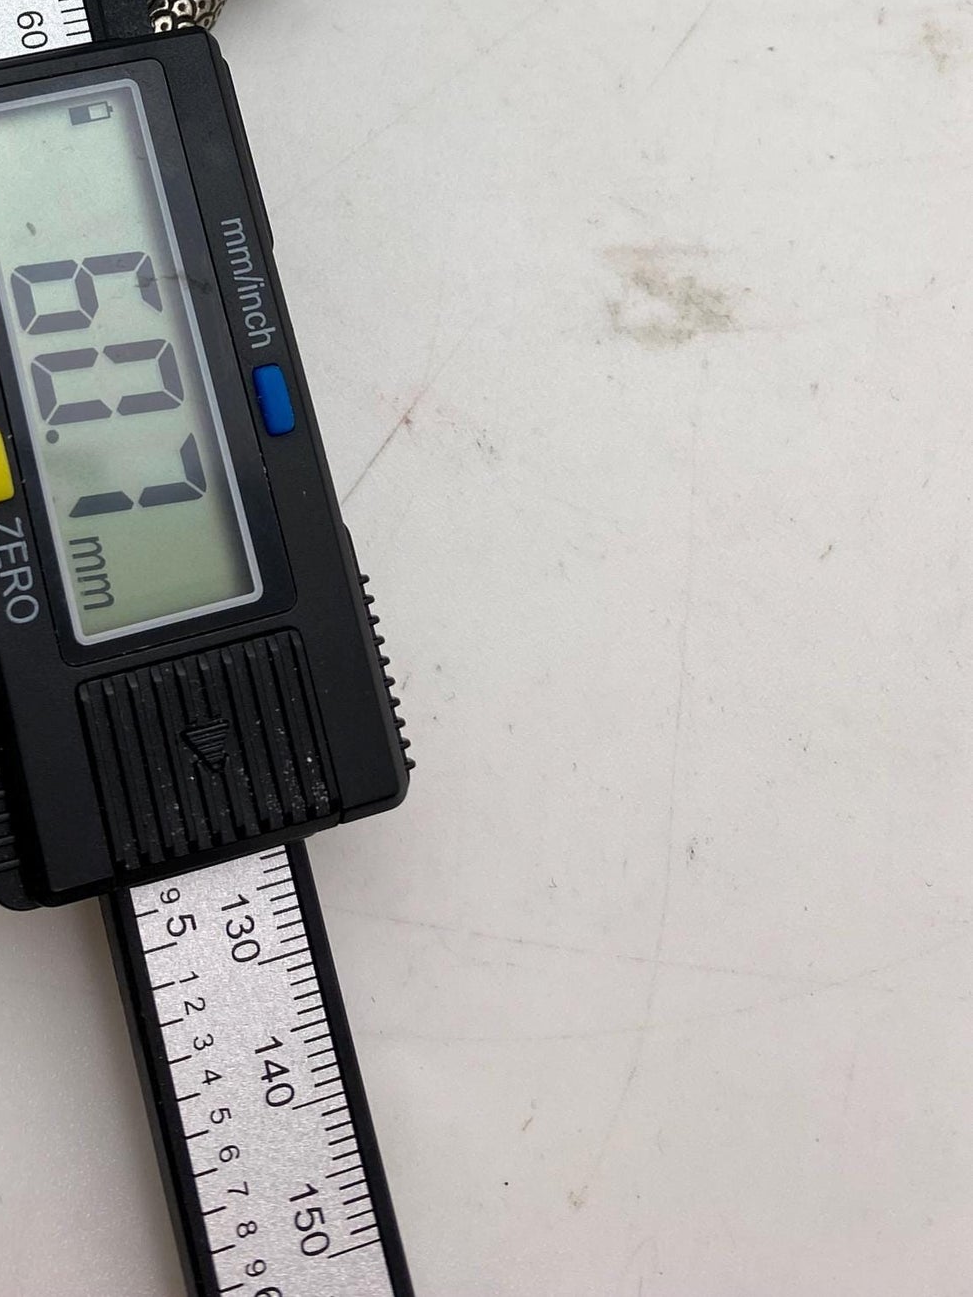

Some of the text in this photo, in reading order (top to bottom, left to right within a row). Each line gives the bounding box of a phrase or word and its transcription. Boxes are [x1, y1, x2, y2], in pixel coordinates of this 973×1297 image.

[17, 11, 48, 49] 60
[221, 218, 275, 348] mm/inch
[160, 888, 267, 1277] 9 5 1 2 3 4 5 6 7 8 9
[221, 894, 330, 1256] 130 140 150
